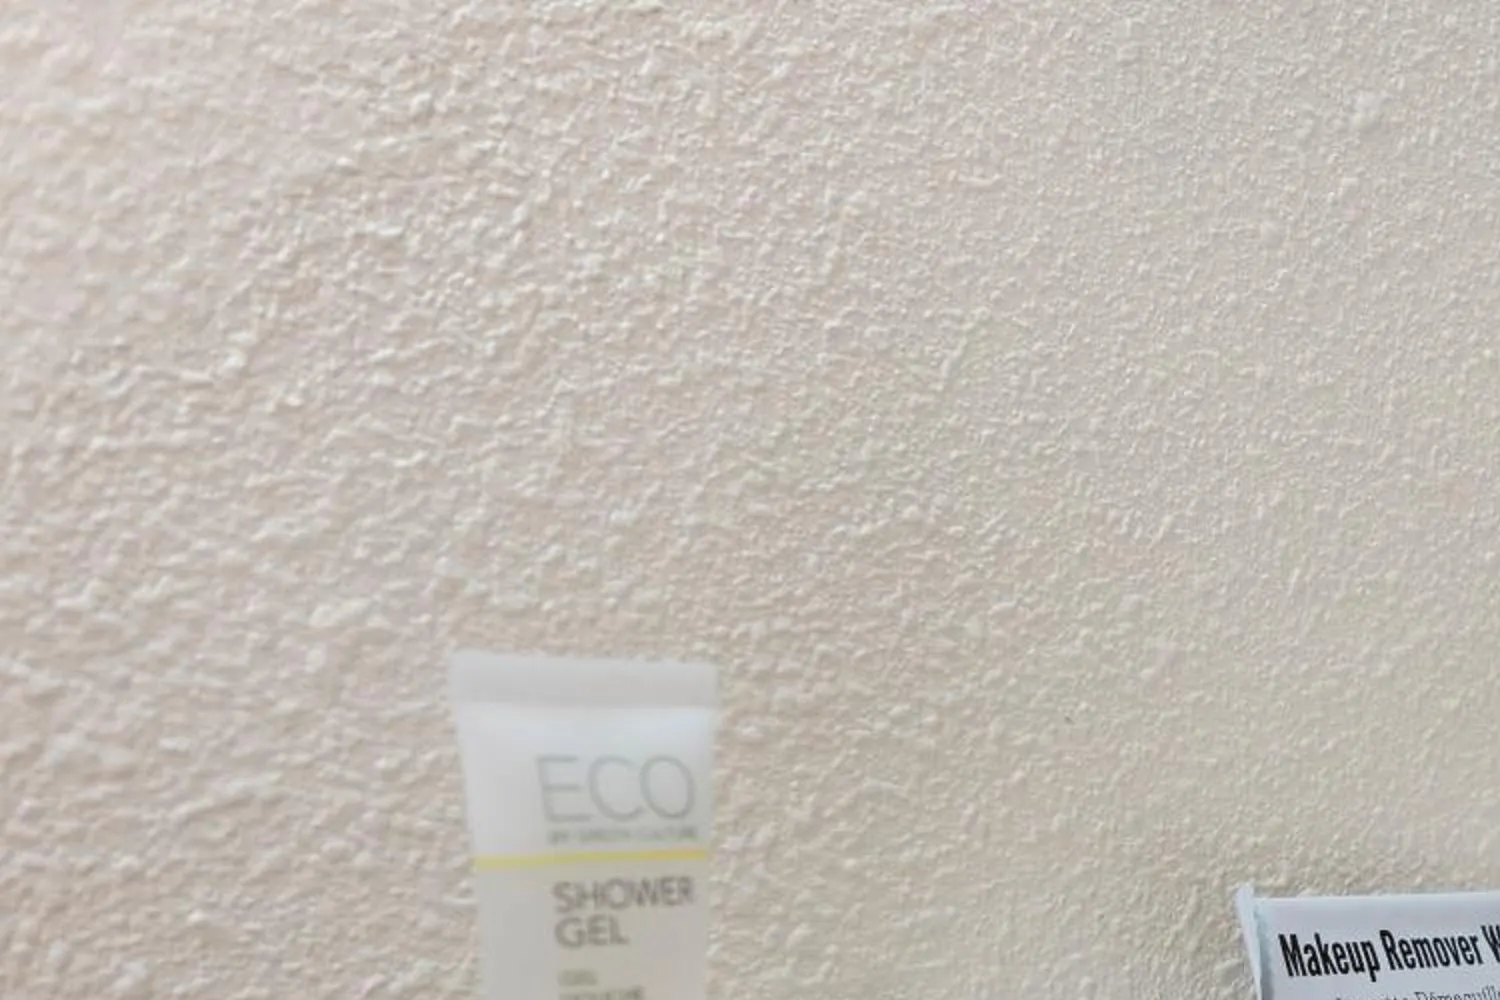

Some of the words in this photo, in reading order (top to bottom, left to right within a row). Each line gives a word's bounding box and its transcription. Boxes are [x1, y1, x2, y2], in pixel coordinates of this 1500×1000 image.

[537, 754, 697, 823] ECO
[553, 875, 695, 914] SHOWER
[554, 915, 630, 948] GEL
[1279, 932, 1380, 982] Makeup
[1379, 929, 1483, 971] Remover
